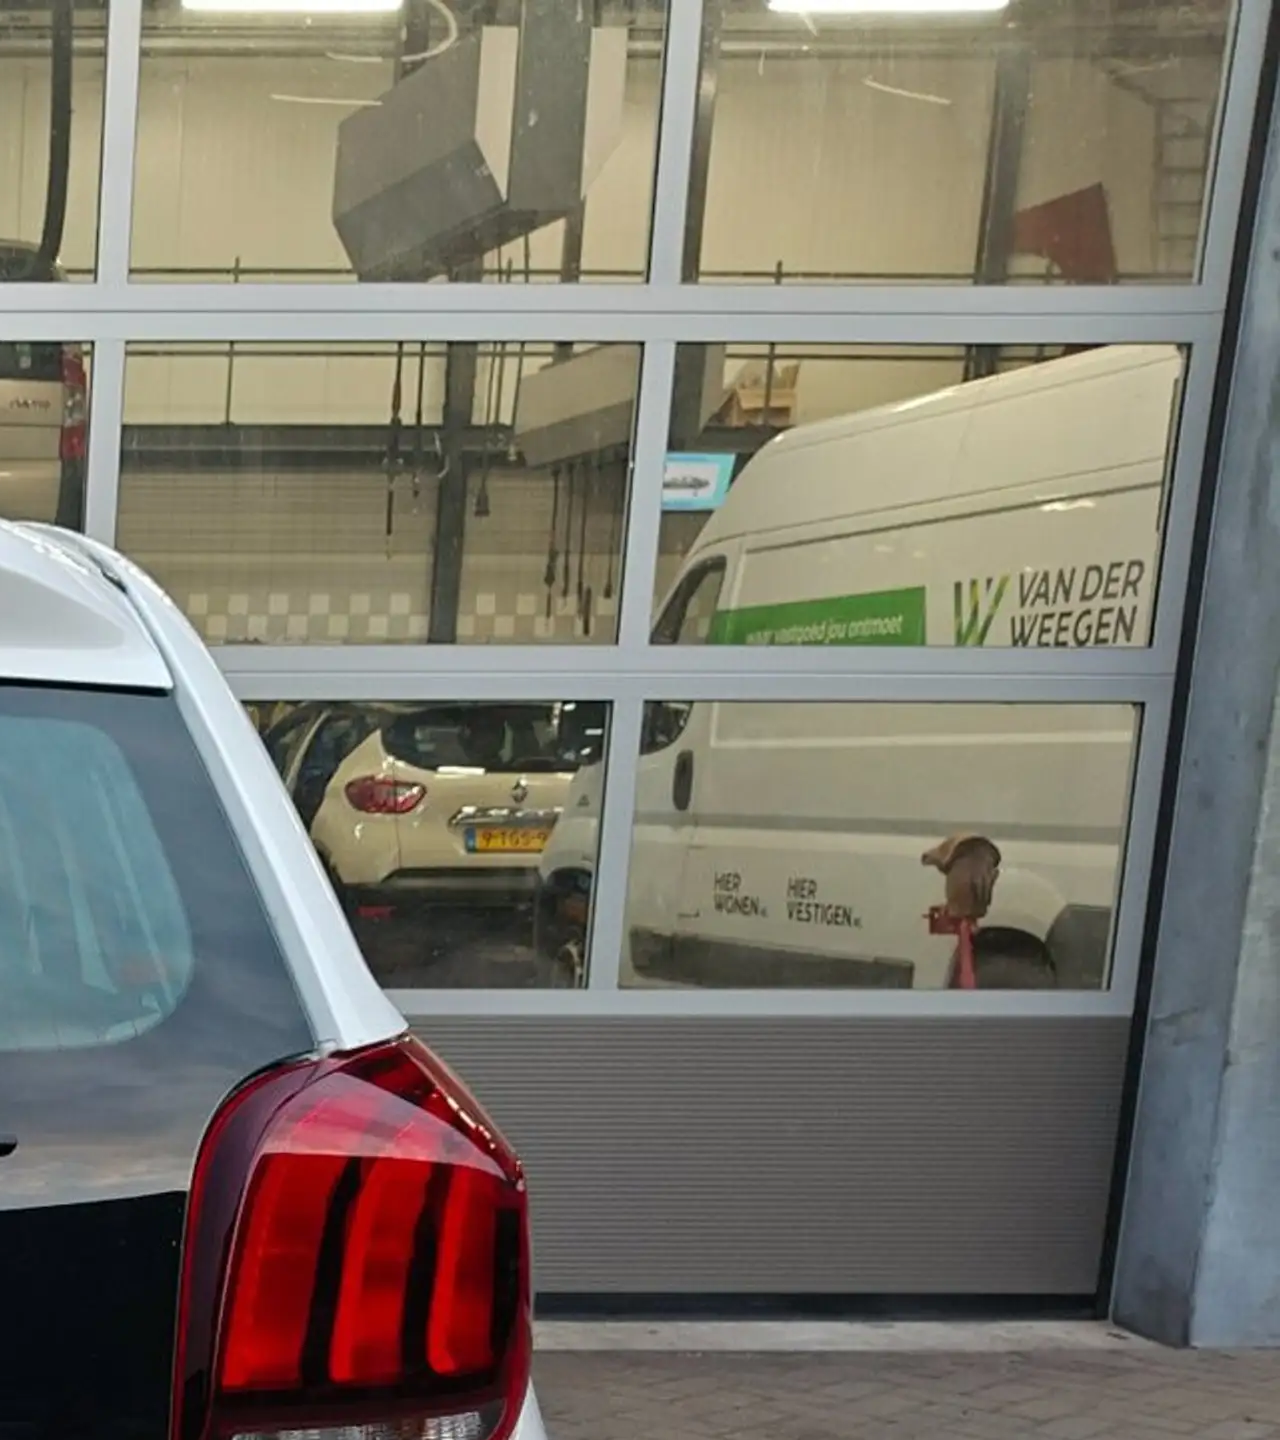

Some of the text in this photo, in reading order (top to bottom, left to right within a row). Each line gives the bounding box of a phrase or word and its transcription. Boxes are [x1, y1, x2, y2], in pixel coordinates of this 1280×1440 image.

[1018, 559, 1145, 608] VAN DER
[1010, 604, 1138, 647] WEEGEN
